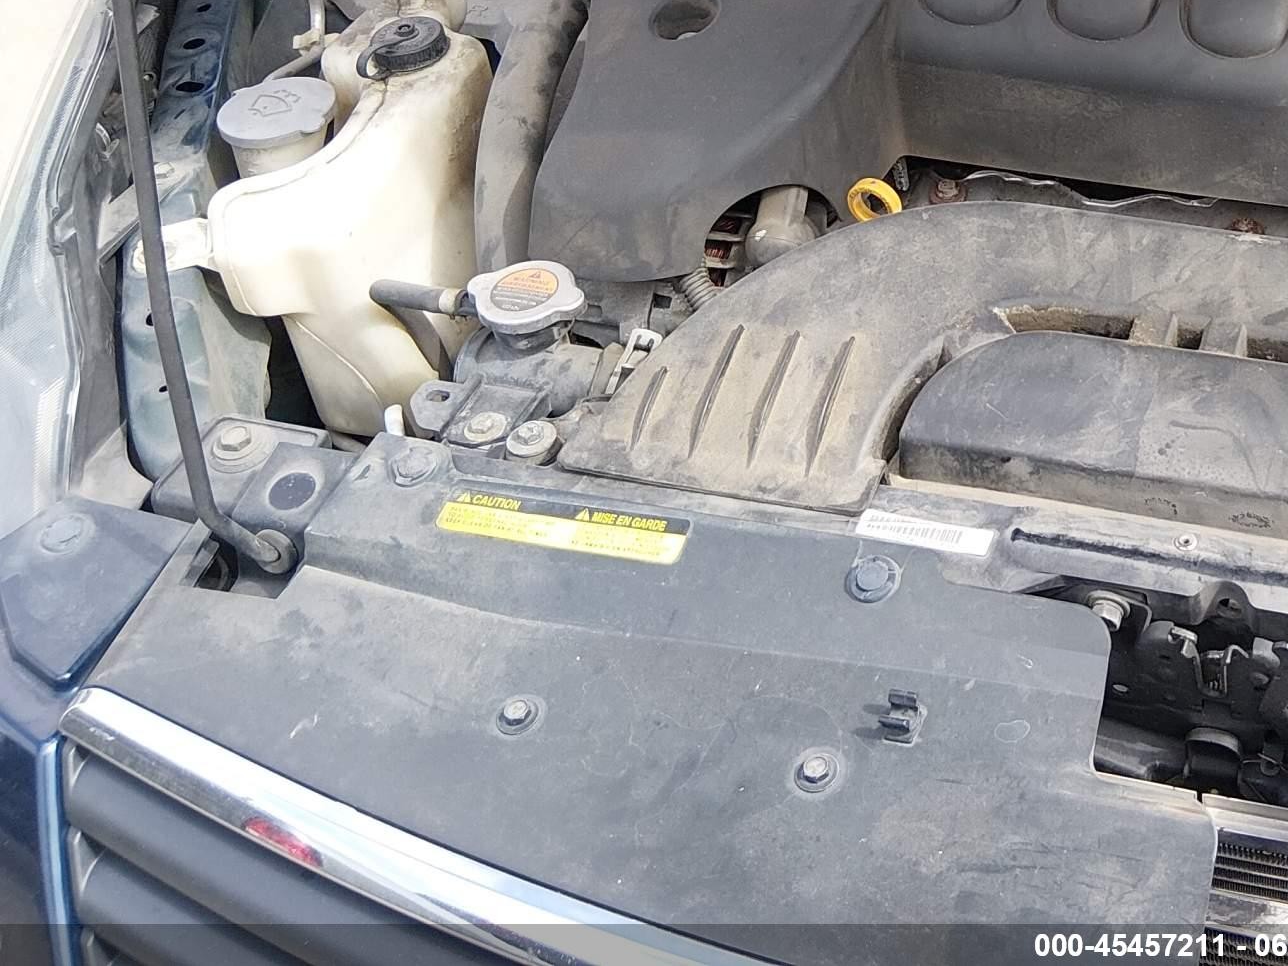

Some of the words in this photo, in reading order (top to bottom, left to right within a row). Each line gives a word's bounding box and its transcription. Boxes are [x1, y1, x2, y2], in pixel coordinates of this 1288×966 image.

[472, 494, 522, 511] CAUTION
[591, 511, 616, 525] MISE
[616, 514, 631, 526] EN
[631, 516, 668, 532] GARDE
